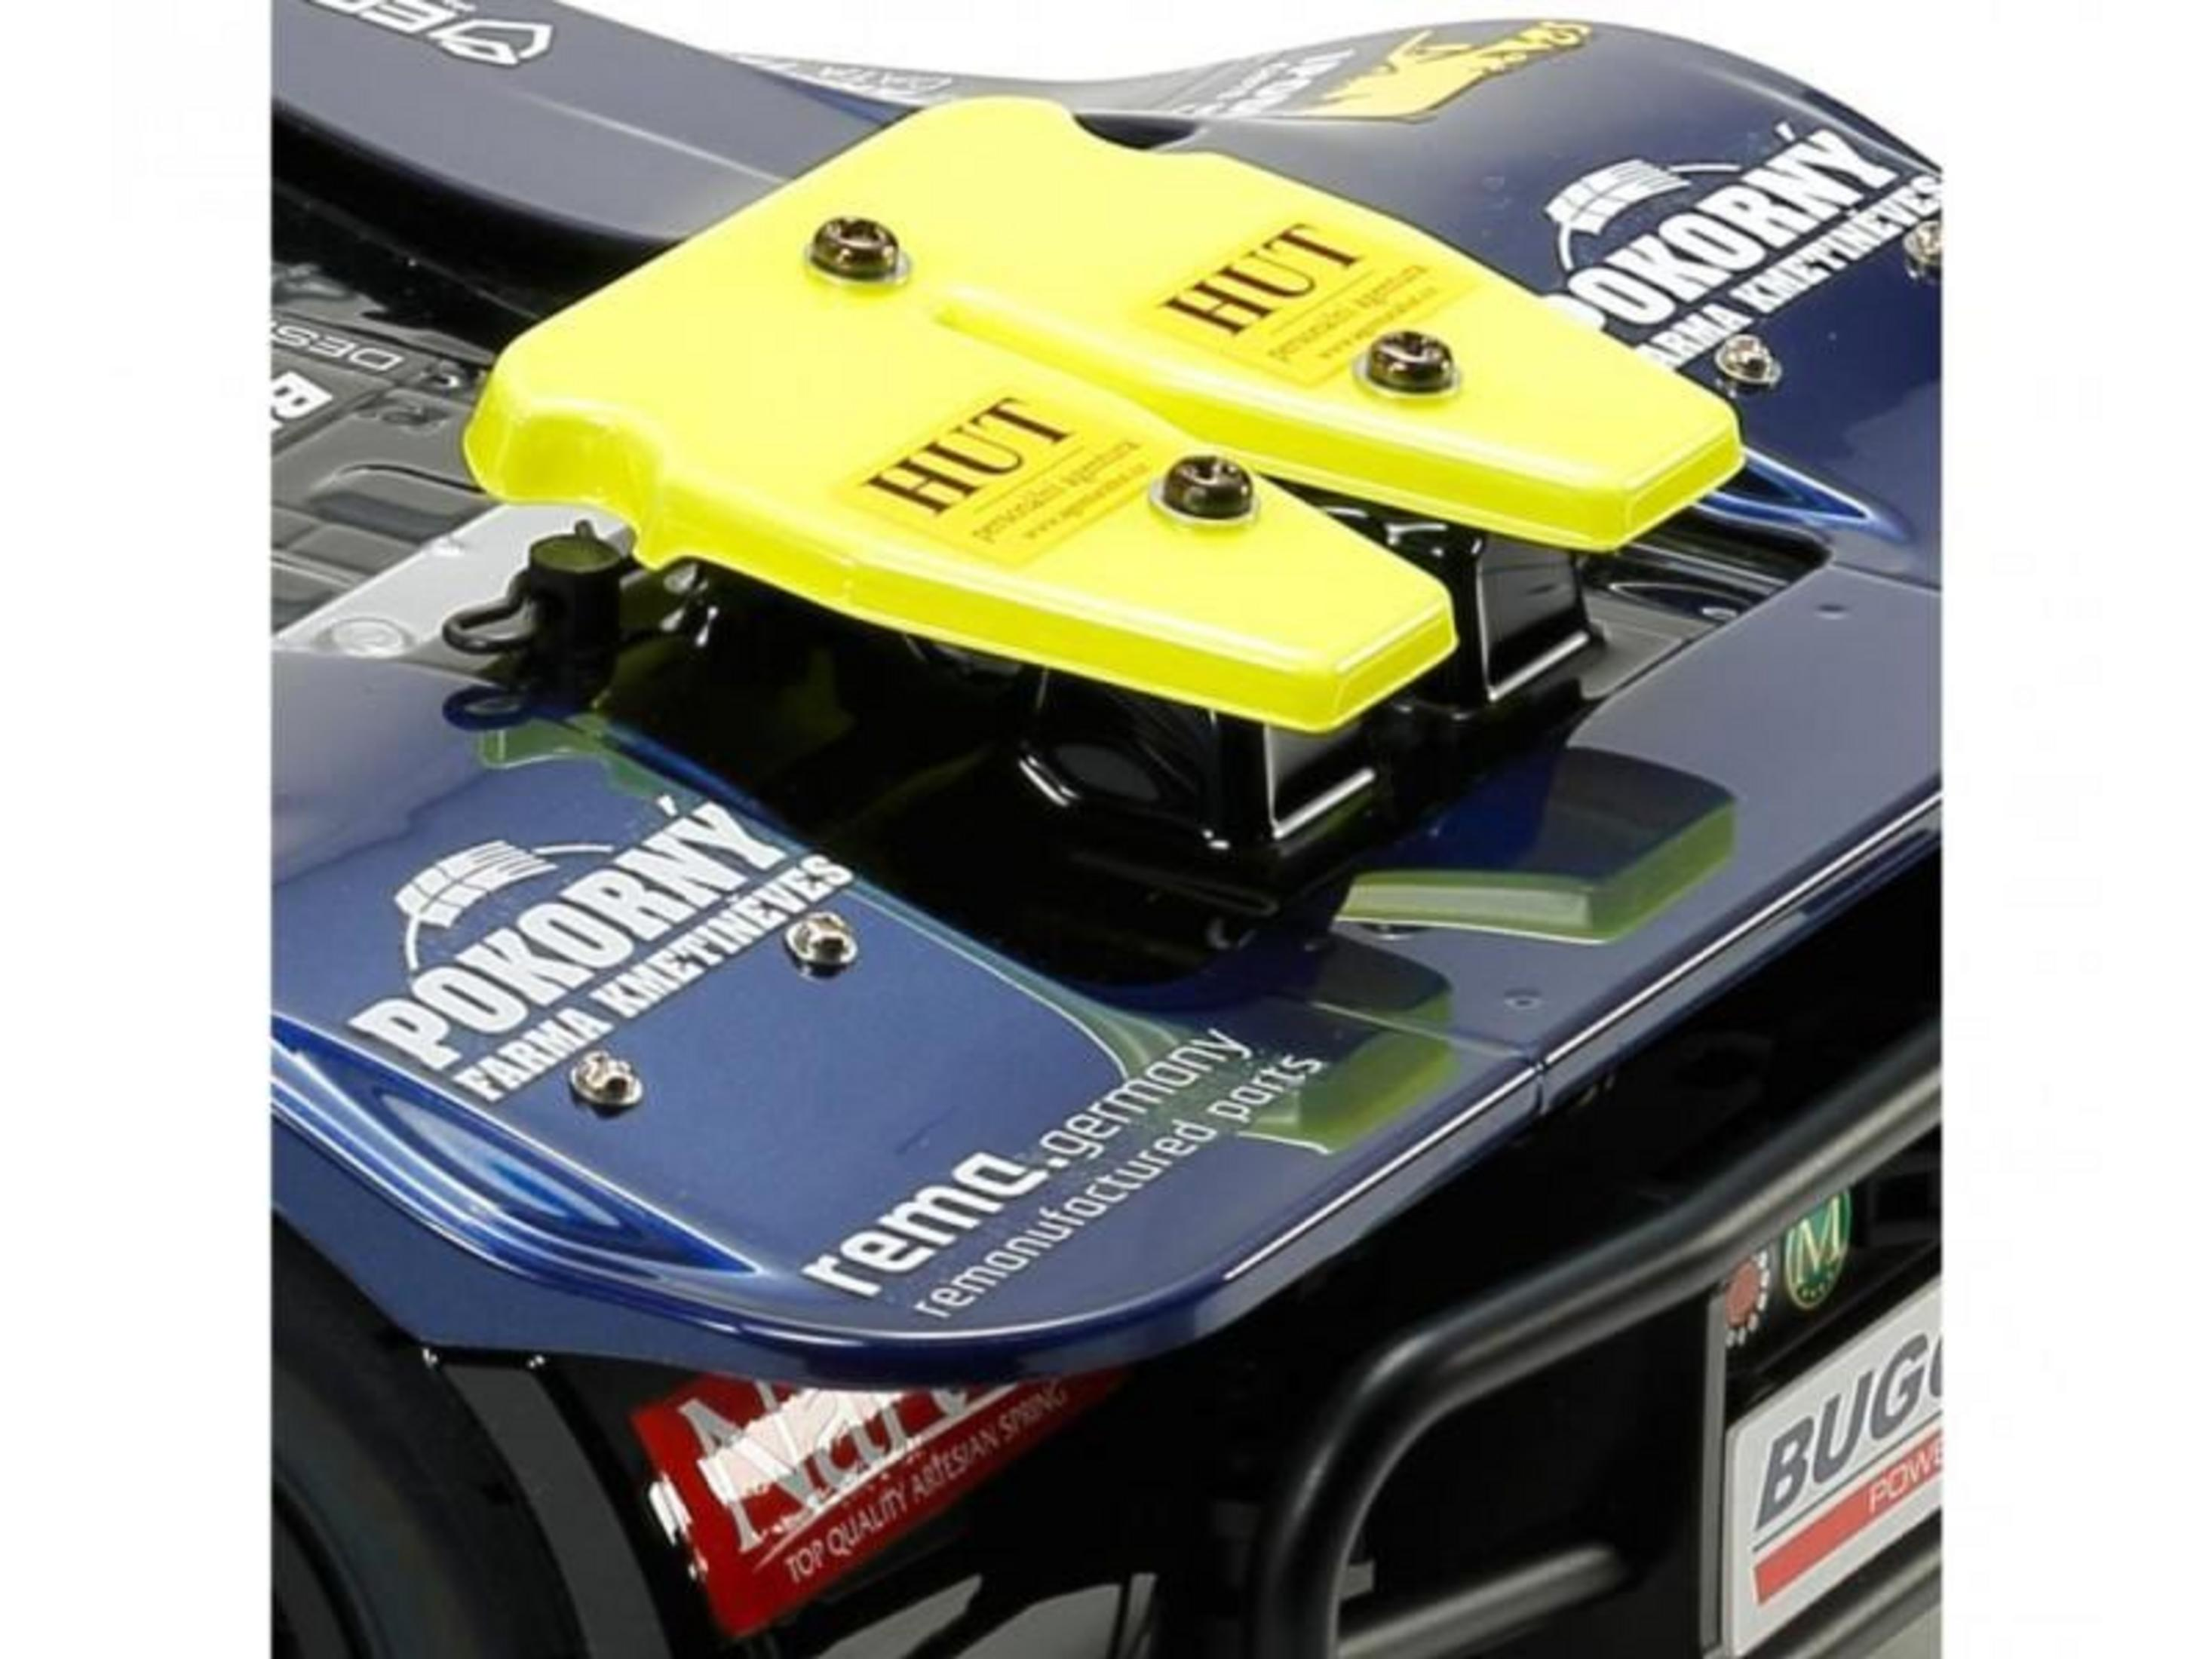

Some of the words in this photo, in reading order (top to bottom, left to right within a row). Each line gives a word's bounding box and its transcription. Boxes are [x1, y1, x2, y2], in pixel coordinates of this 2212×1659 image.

[272, 320, 406, 372] DES
[1157, 222, 1363, 336] HUT
[864, 396, 1075, 516] HUT
[348, 795, 787, 1069] POKORNÝ
[454, 1008, 614, 1102] FARMA
[915, 1119, 1217, 1318] remanufactured
[1207, 1053, 1323, 1124] parts
[784, 1540, 825, 1583] TOP
[828, 1483, 907, 1556] QUALITY
[910, 1427, 1000, 1503] ARTESIAN
[997, 1381, 1069, 1443] SPRING
[1756, 1332, 1942, 1531] BUG
